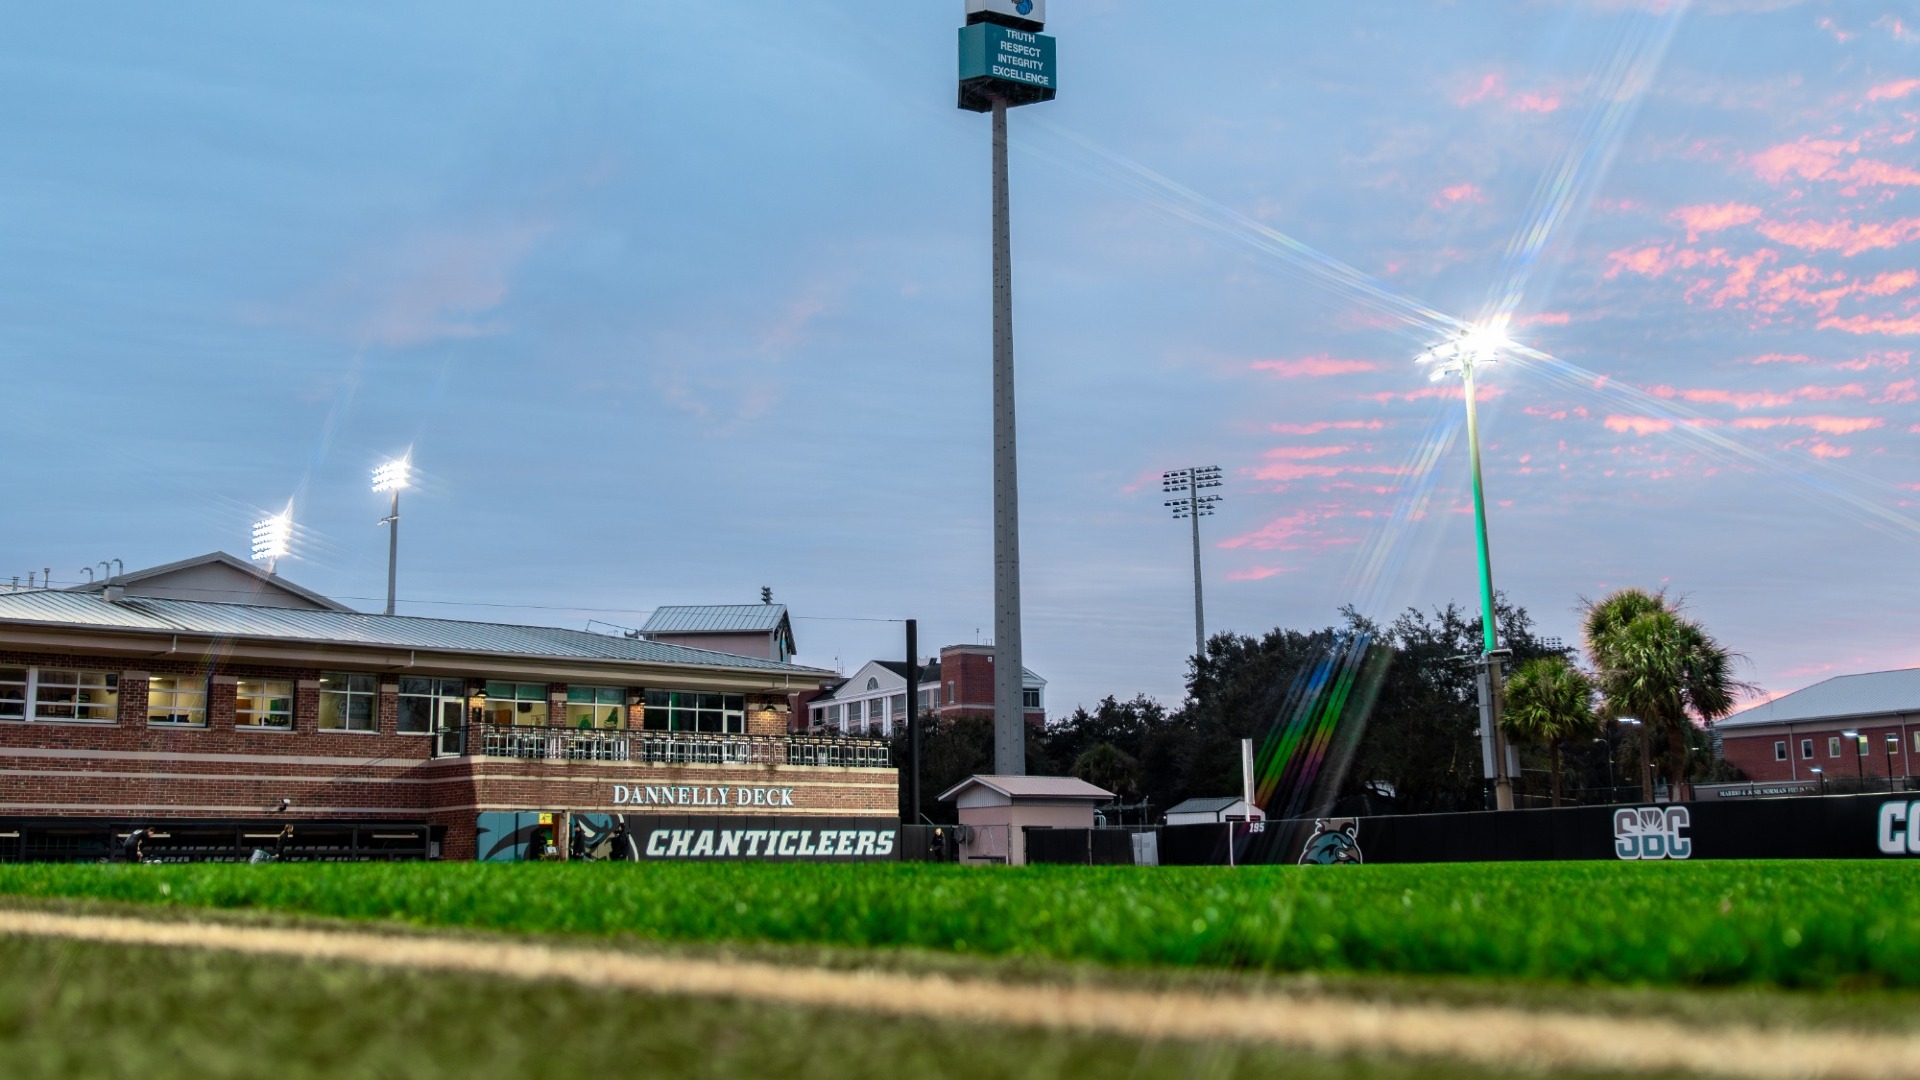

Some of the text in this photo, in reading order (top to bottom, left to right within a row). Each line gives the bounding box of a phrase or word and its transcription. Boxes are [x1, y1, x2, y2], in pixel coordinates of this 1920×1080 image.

[1006, 29, 1035, 43] TRUTH
[1000, 41, 1041, 58] RESPECT
[998, 53, 1043, 71] INTEGRITY
[992, 65, 1049, 85] EXCELLENCE
[613, 785, 794, 806] DANNELLY DECK
[1249, 822, 1265, 833] 195
[1613, 806, 1691, 859] SBC
[645, 829, 897, 856] CHANTICLEERS
